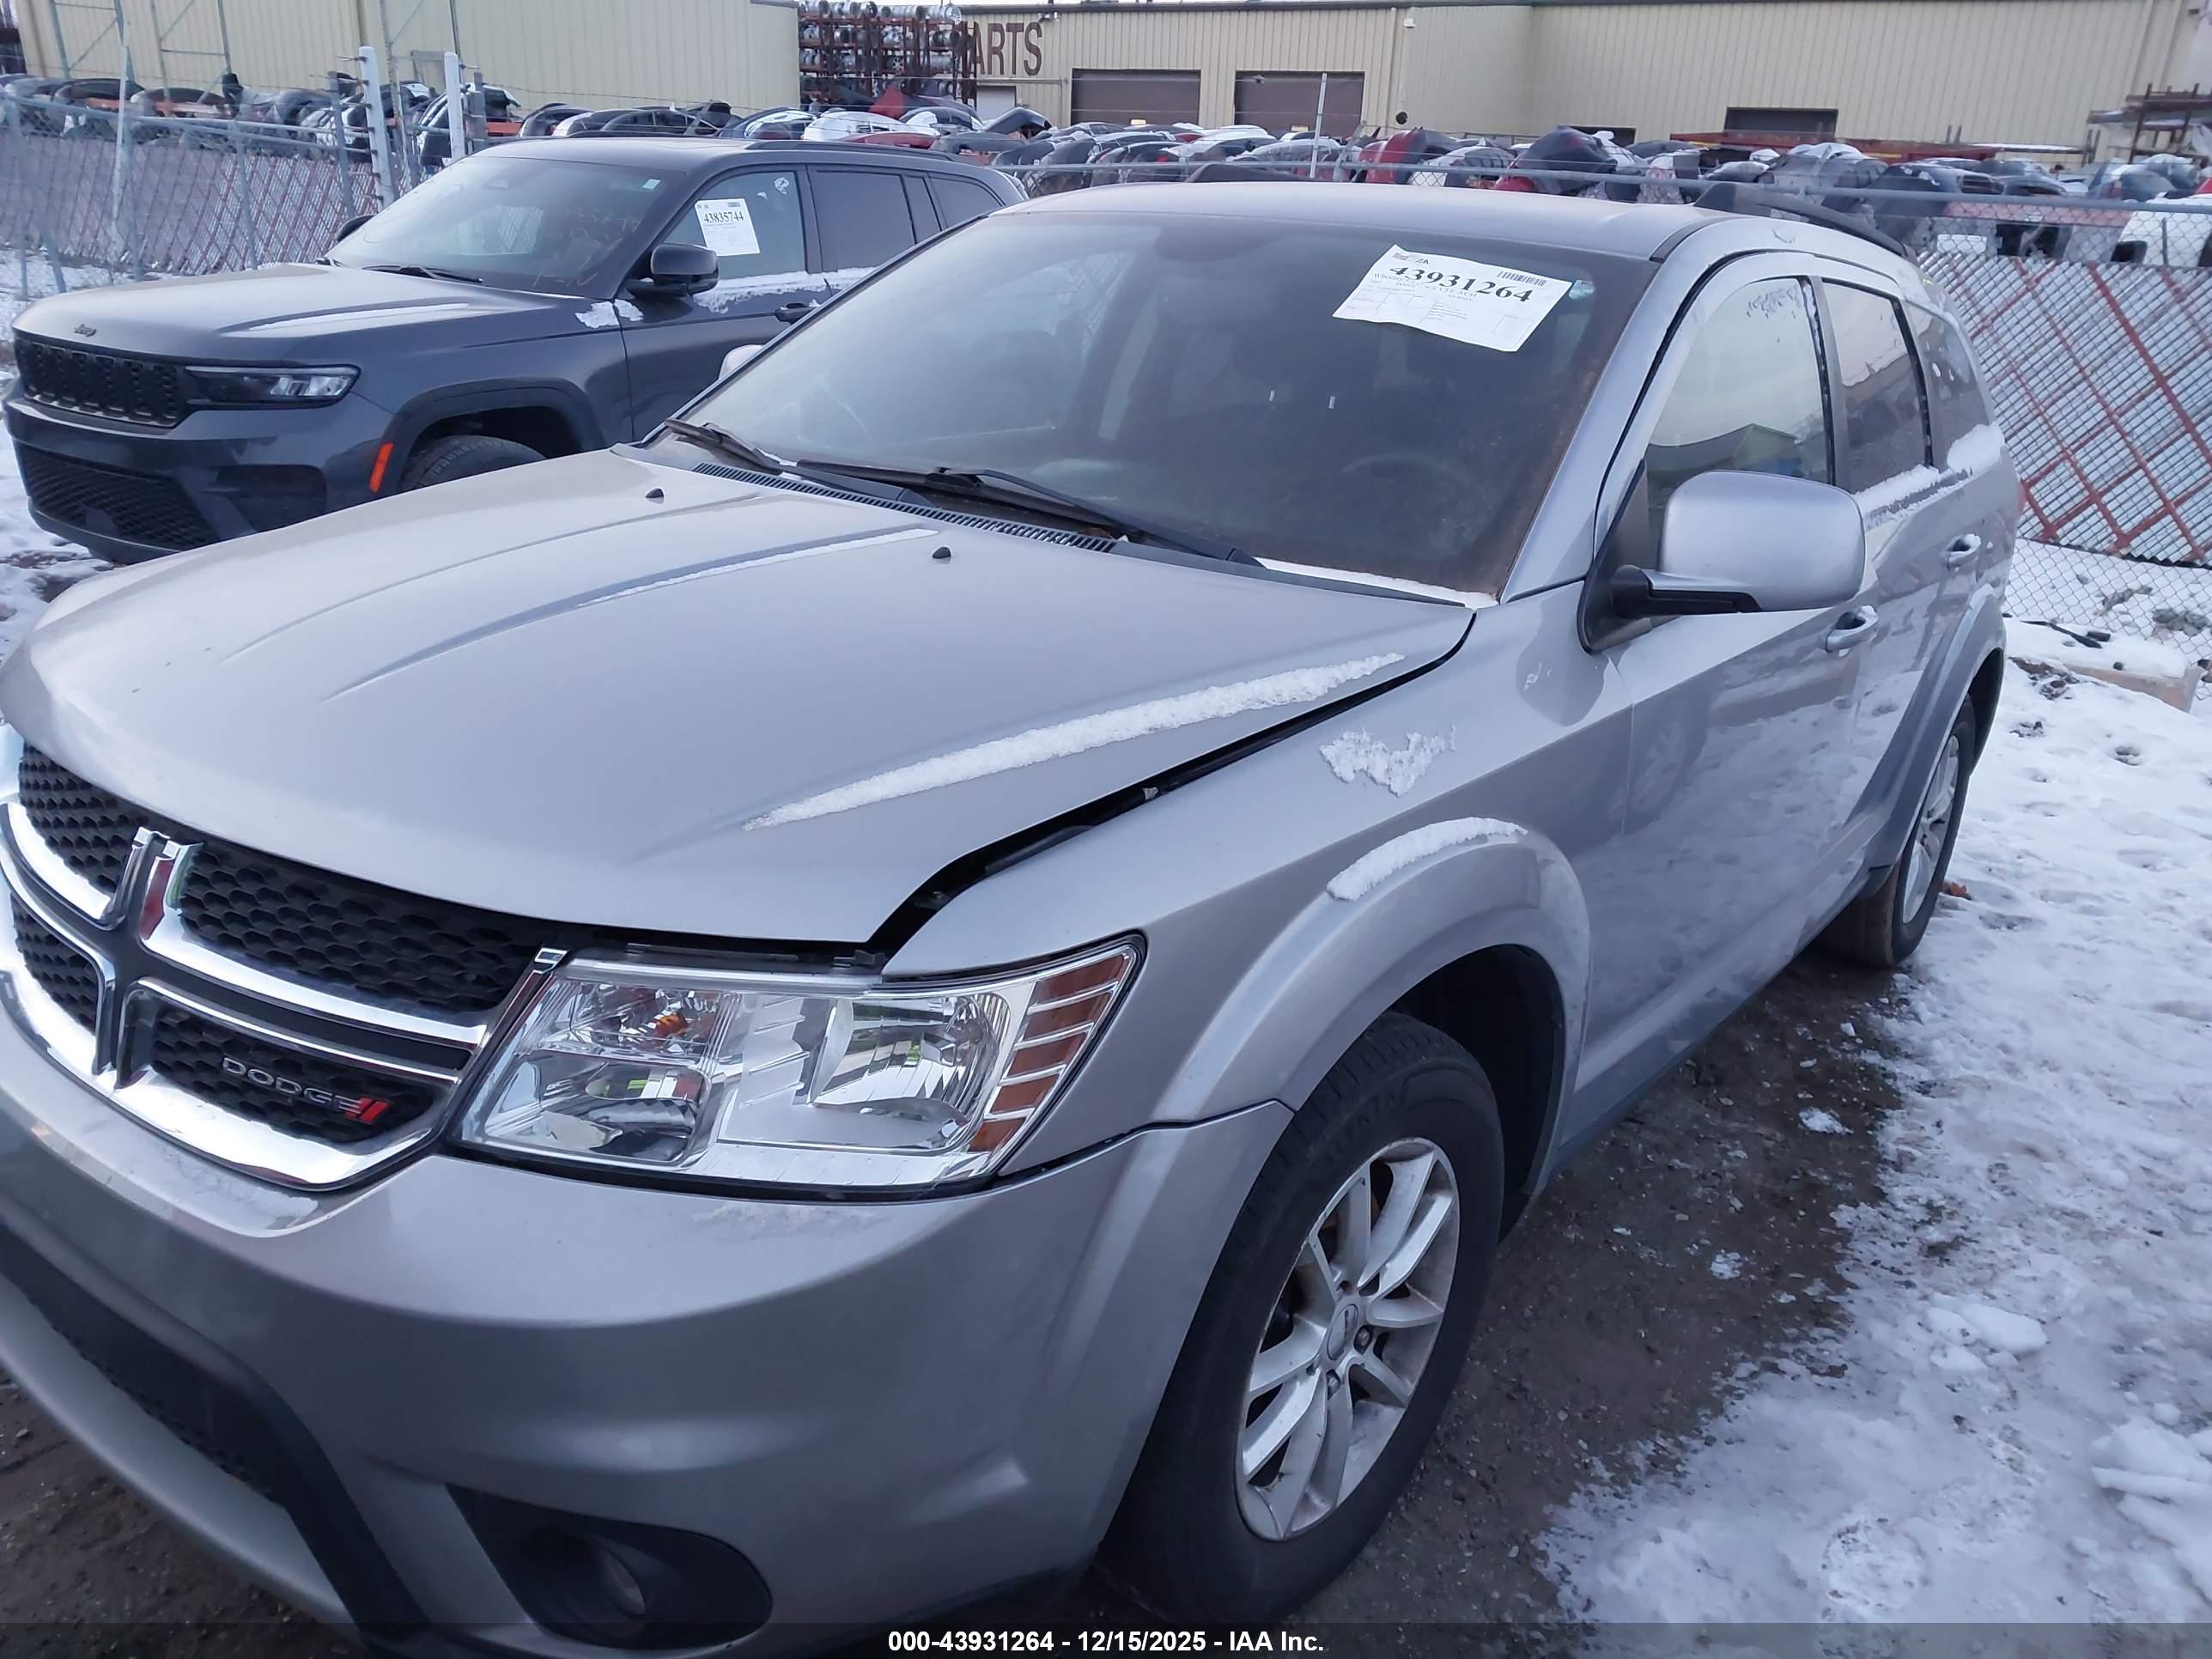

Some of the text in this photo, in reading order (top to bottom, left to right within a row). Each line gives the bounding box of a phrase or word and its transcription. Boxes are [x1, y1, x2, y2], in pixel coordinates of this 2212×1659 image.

[951, 21, 1042, 76] ARTS
[703, 210, 744, 223] 43835744
[1389, 266, 1534, 303] 43931264
[222, 1057, 362, 1115] DODGE
